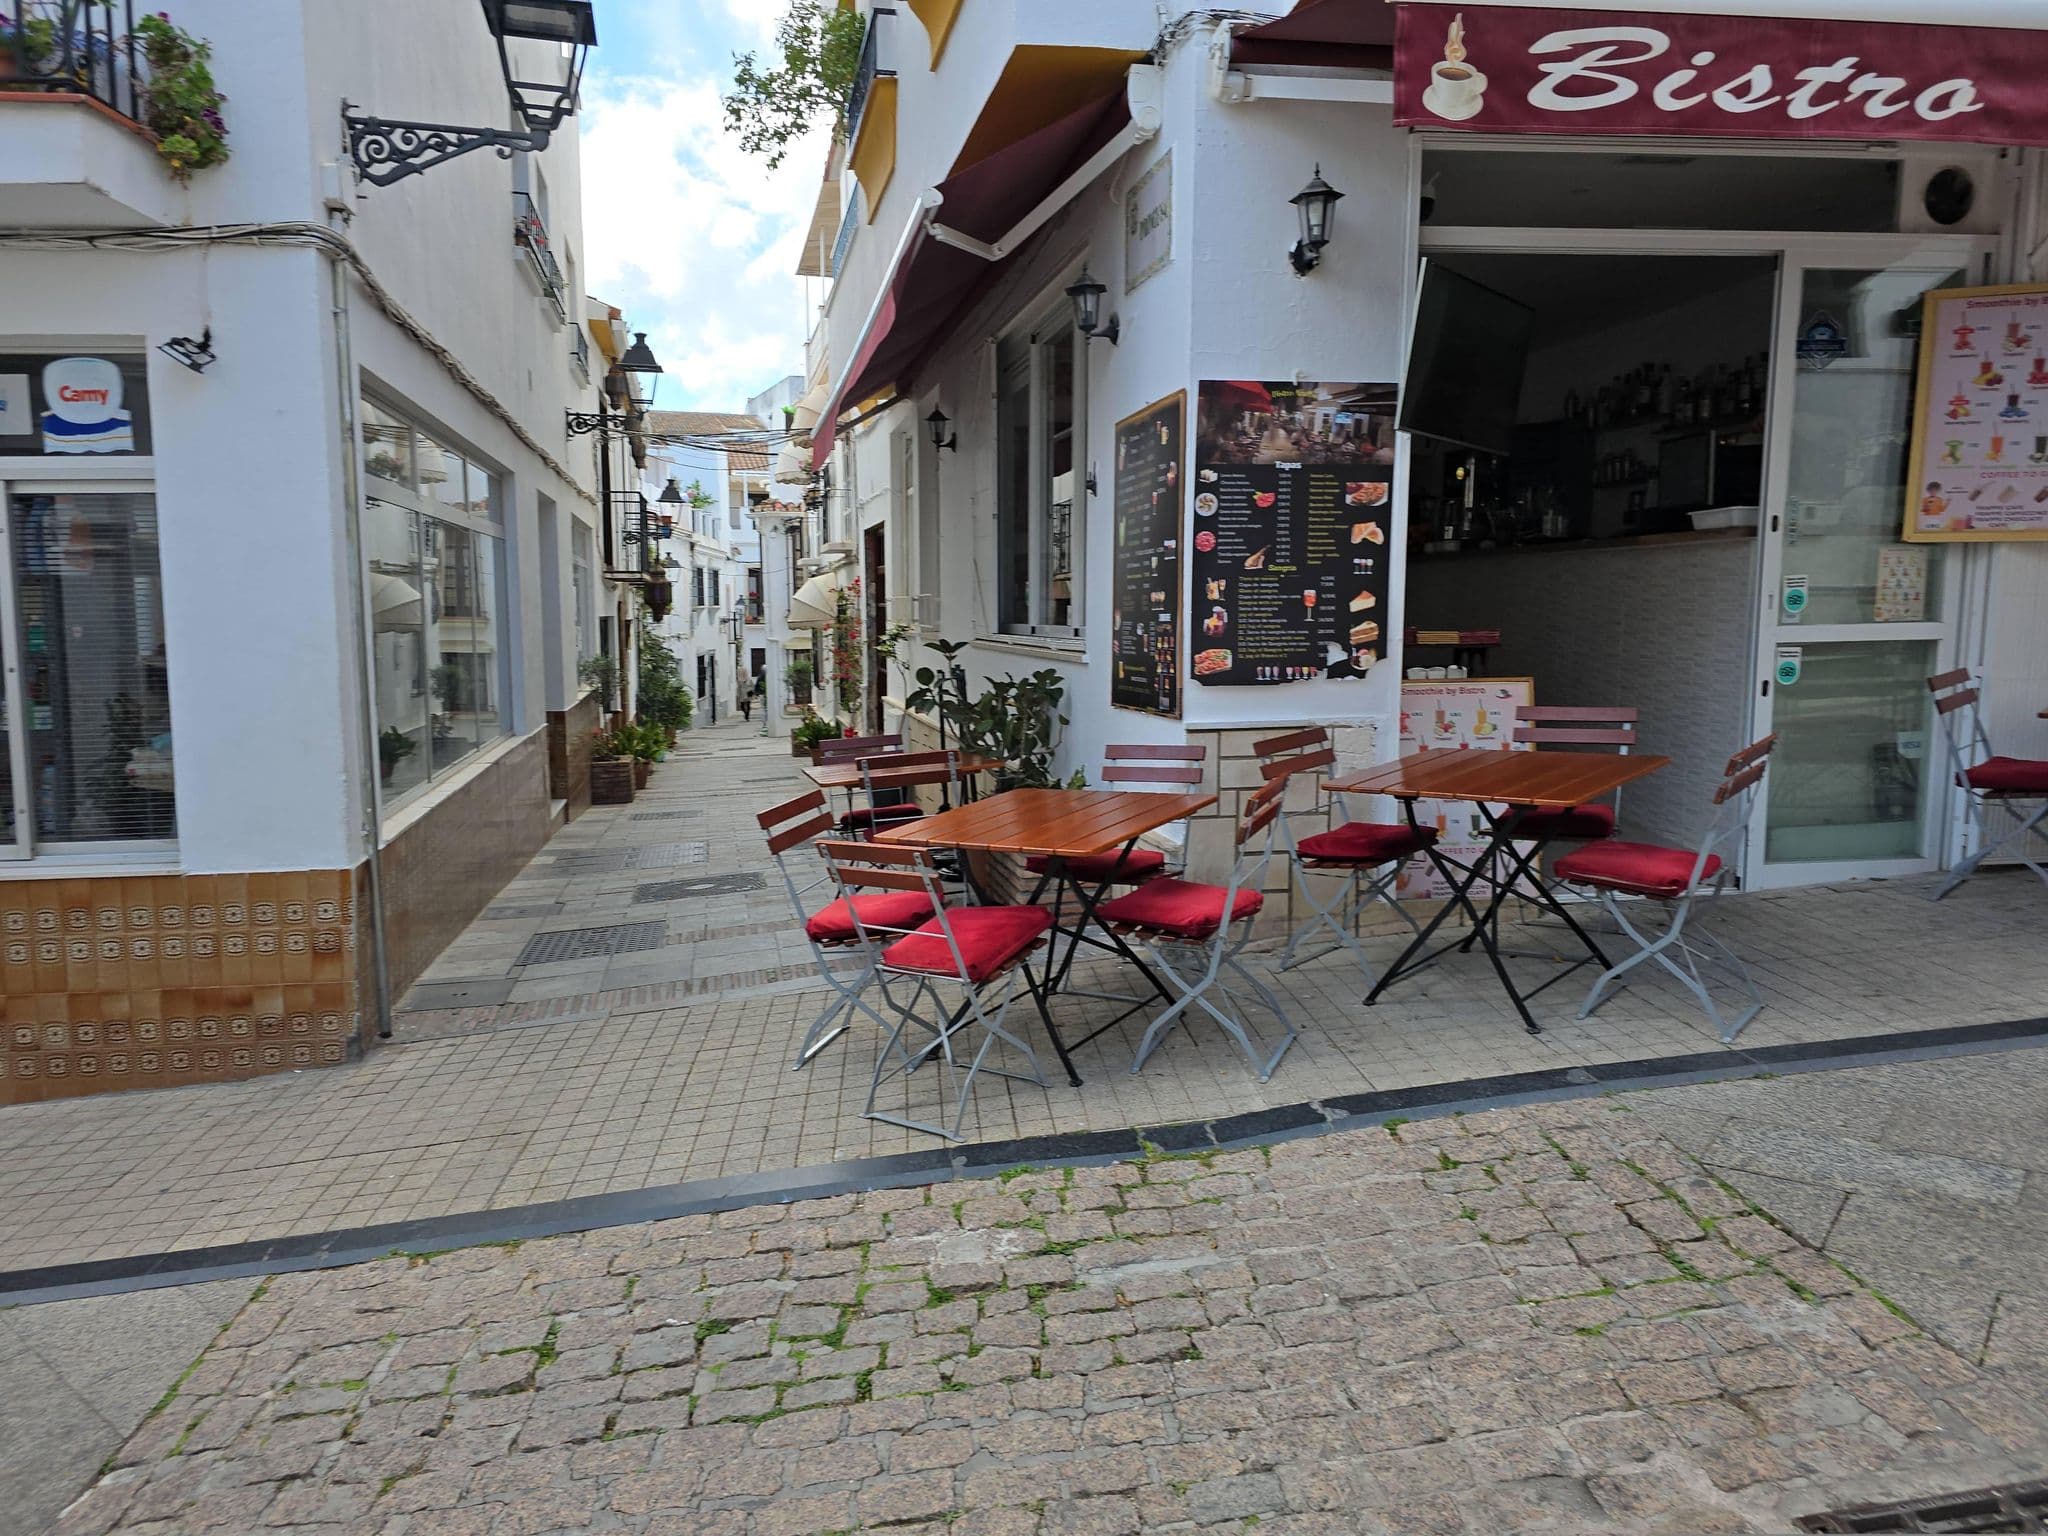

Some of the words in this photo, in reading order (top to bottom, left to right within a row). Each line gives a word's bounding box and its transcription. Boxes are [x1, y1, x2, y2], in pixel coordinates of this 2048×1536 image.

[1526, 25, 1985, 121] Bistro
[59, 385, 109, 405] Camy
[1274, 460, 1302, 471] Tapas
[1401, 687, 1444, 696] Smoothie
[1445, 687, 1457, 696] by
[1459, 686, 1486, 695] Bistro
